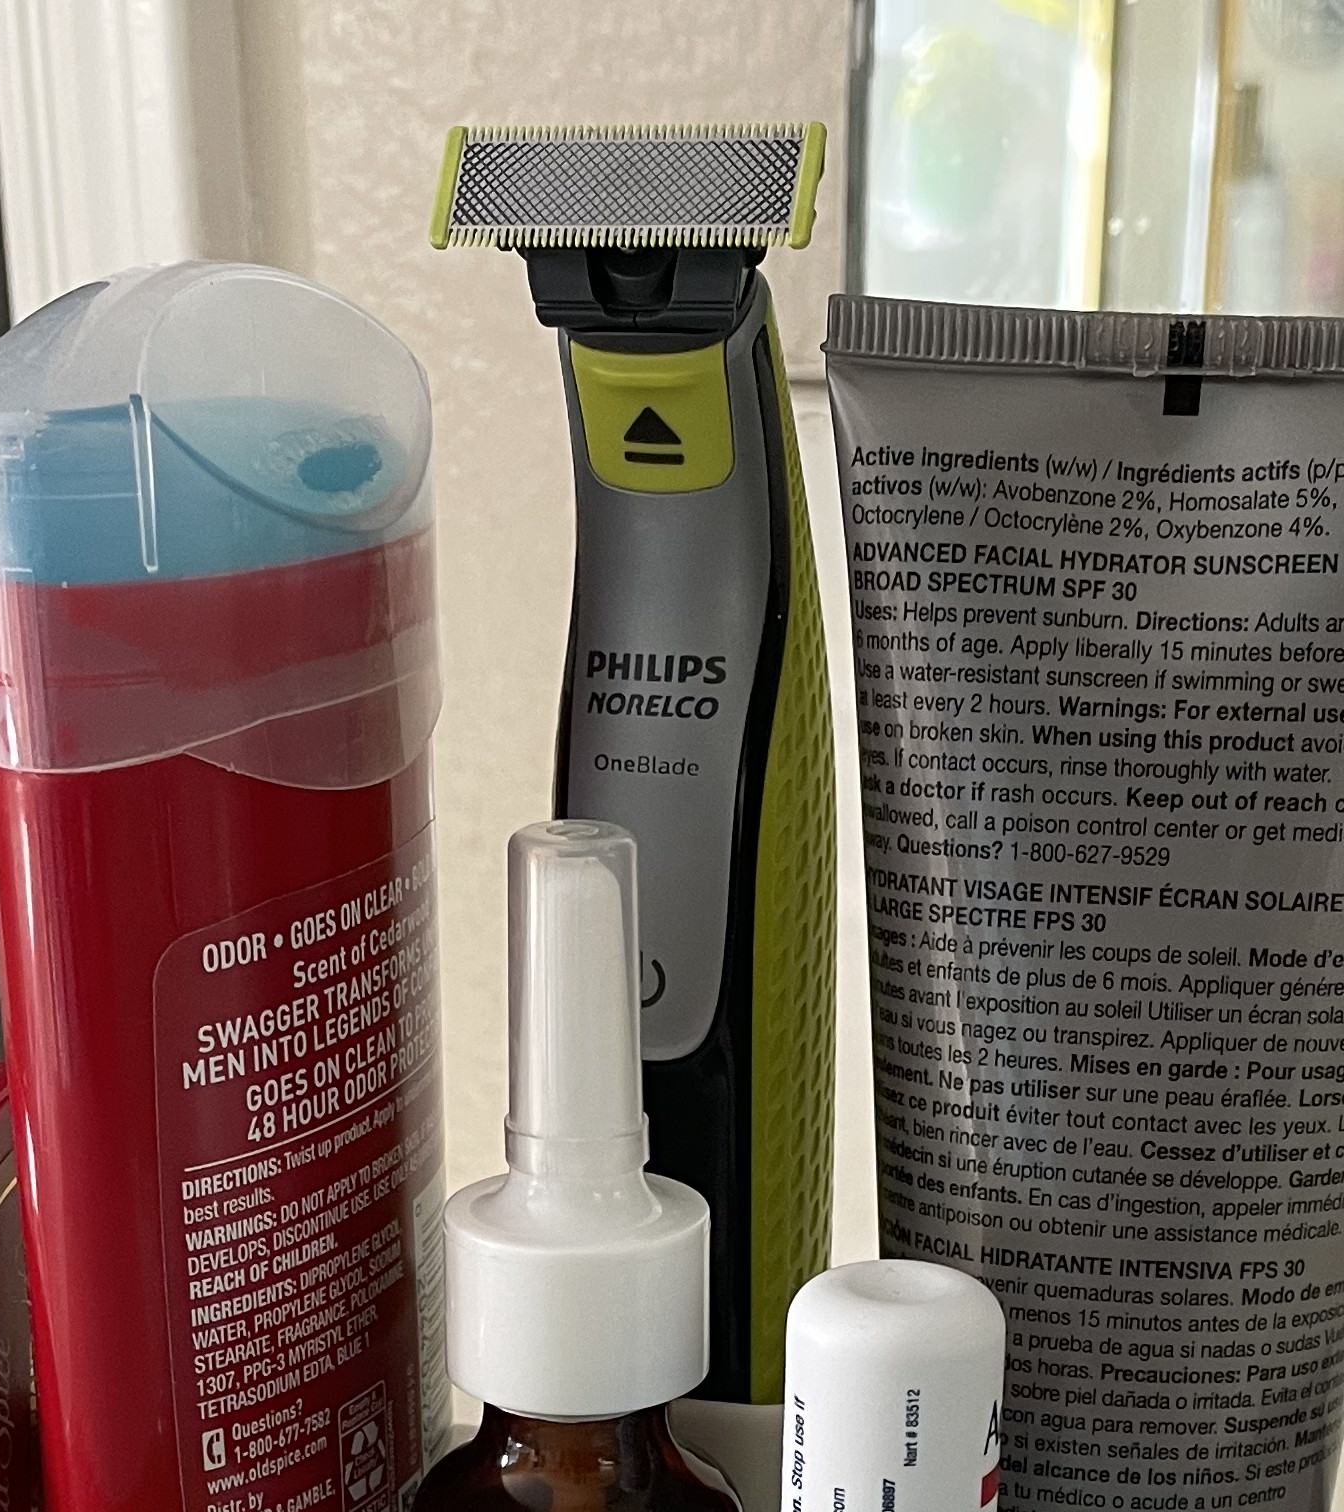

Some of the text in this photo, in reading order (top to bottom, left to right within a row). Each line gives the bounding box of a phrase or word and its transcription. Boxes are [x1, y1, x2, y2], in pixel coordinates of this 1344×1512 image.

[851, 445, 915, 467] Active
[921, 446, 1039, 473] ingredients
[1046, 453, 1097, 482] (w/w)
[1117, 461, 1235, 486] Ingrédients
[1242, 460, 1300, 482] actifs
[852, 474, 922, 495] activos
[929, 475, 987, 503] (w/w):
[992, 479, 1116, 508] Avobenzone
[1121, 490, 1162, 514] 2%,
[1169, 490, 1290, 512] Homosalate
[1296, 486, 1337, 511] 5%,
[852, 503, 1330, 544] Octocrylene Octocrylène 2%, Oxybenzone 4%.
[853, 541, 1339, 575] ADVANCED FACIAL HYDRATOR SUNSCREEN
[854, 569, 1137, 602] BROAD SPECTRUM SPF 30
[855, 598, 898, 623] Uses:
[903, 601, 957, 627] Helps
[963, 606, 1037, 628] prevent
[1042, 608, 1128, 630] sunburn.
[1136, 611, 1249, 632] Directions:
[1254, 611, 1319, 633] Adults
[586, 651, 727, 684] PHILIPS
[587, 692, 719, 720] NORELCO
[594, 754, 700, 776] OneBlade
[964, 879, 1344, 912] VISAGE INTENSIF ÉCRAN SOLAIRE
[203, 876, 403, 972] ODOR GOES ON CLEAR
[928, 903, 1026, 929] SPECTRE
[1033, 910, 1075, 931] FPS
[1081, 913, 1106, 933] 30
[293, 934, 366, 988] Scent of
[182, 978, 408, 1090] MEN INTO LEGENDS OF
[198, 994, 319, 1053] SWAGGER
[246, 1012, 413, 1111] GOES ON CLEAN TO
[247, 1061, 387, 1142] 48 HOUR ODOR
[182, 1157, 282, 1200] DIRECTIONS:
[183, 1187, 275, 1225] best results.
[185, 1211, 277, 1252] WARNINGS:
[189, 1232, 338, 1300] REACH OF CHILDREN.
[980, 1245, 1305, 1280] HIDRATANTE INTENSIVA FPS 30
[191, 1278, 297, 1327] INGREDIENTS:
[232, 1398, 303, 1441] Questions?
[794, 1395, 805, 1411] if
[234, 1407, 330, 1464] 1-800-677-7582
[794, 1414, 805, 1446] use
[903, 1389, 921, 1467] Nart 83512
[207, 1436, 327, 1495] www.oldspice.com
[791, 1449, 806, 1490] Stop
[248, 1492, 264, 1510] by
